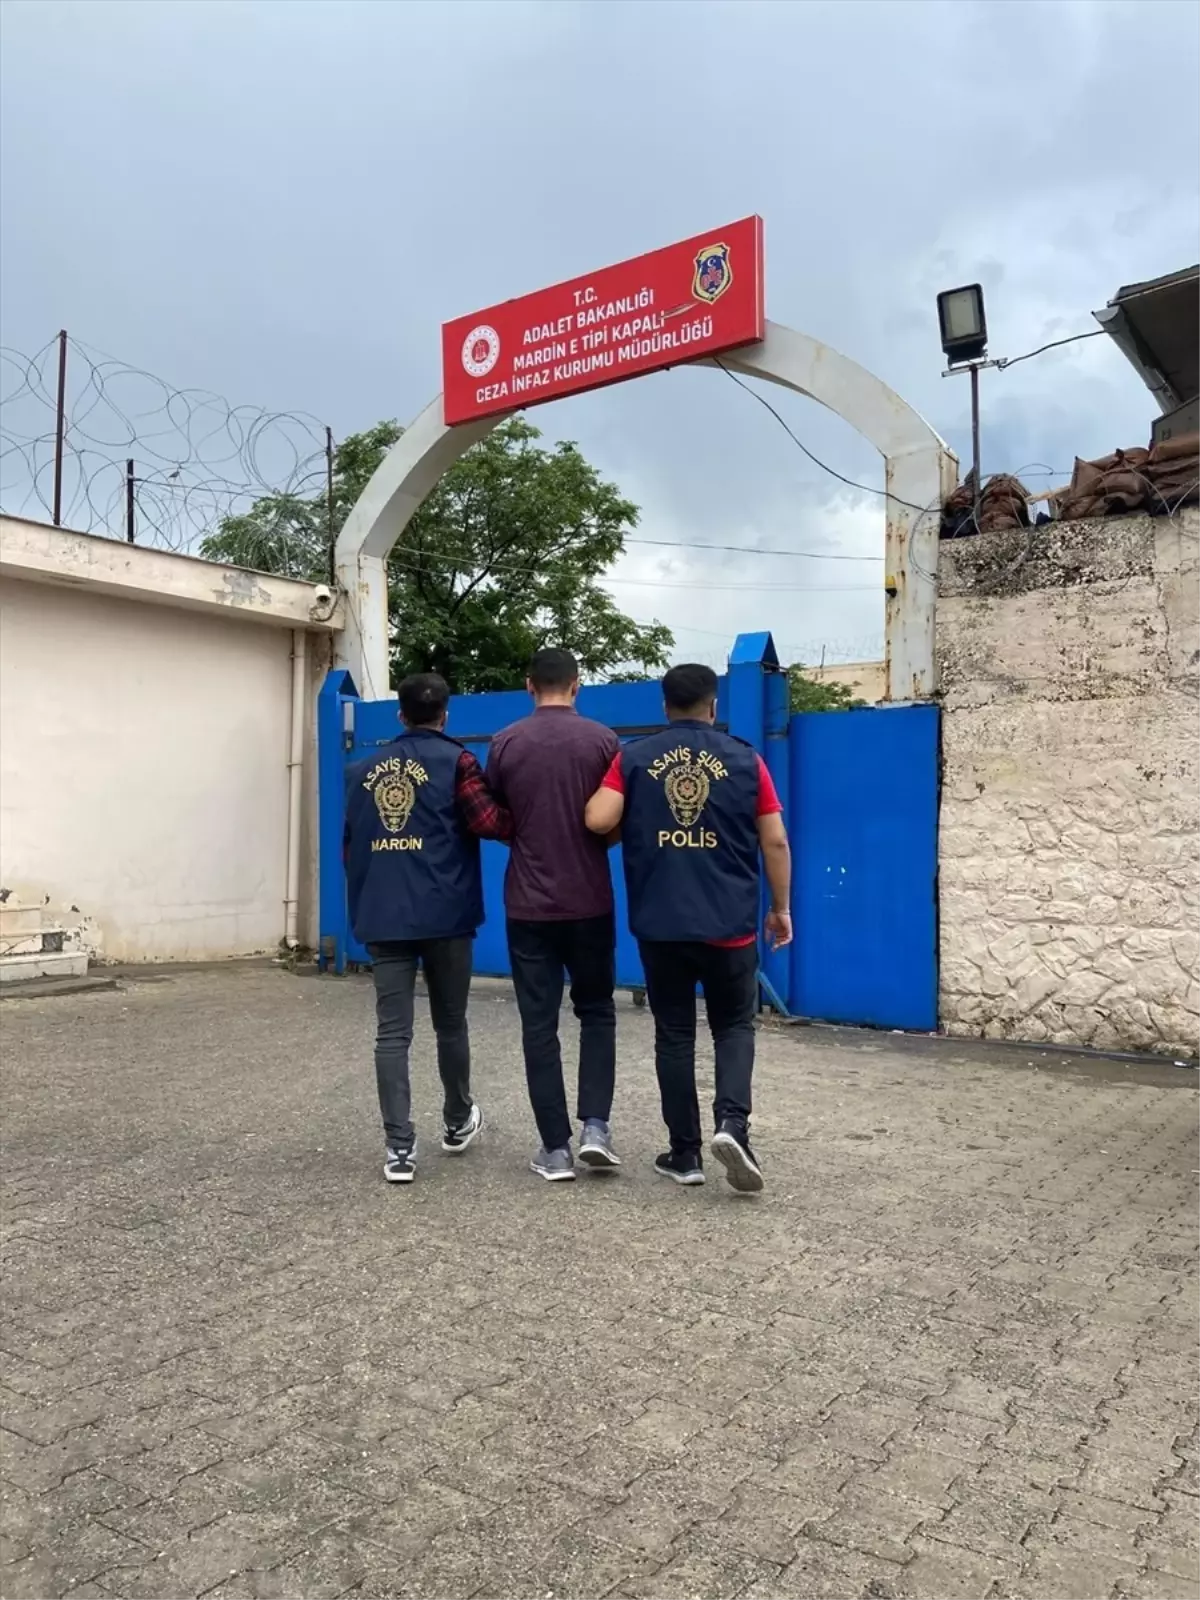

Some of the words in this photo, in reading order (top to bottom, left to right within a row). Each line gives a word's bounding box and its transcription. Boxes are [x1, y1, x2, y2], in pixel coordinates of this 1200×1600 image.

[573, 287, 598, 306] T.C.
[523, 315, 573, 345] ADALET
[576, 287, 654, 330] BAKANLIĞI
[476, 381, 508, 403] CEZA
[511, 370, 550, 394] İNFAZ
[553, 349, 614, 381] KURUMU
[617, 316, 713, 362] MÜDÜRLÜĞÜ
[513, 342, 566, 371] MARDİN
[570, 339, 578, 354] E
[581, 326, 608, 351] TİPİ
[362, 756, 401, 792] ASAYİŞ
[646, 745, 692, 780] ASAYİŞ
[695, 750, 729, 780] ŞUBE
[371, 835, 422, 853] MARDİN
[658, 827, 717, 849] POLİS
